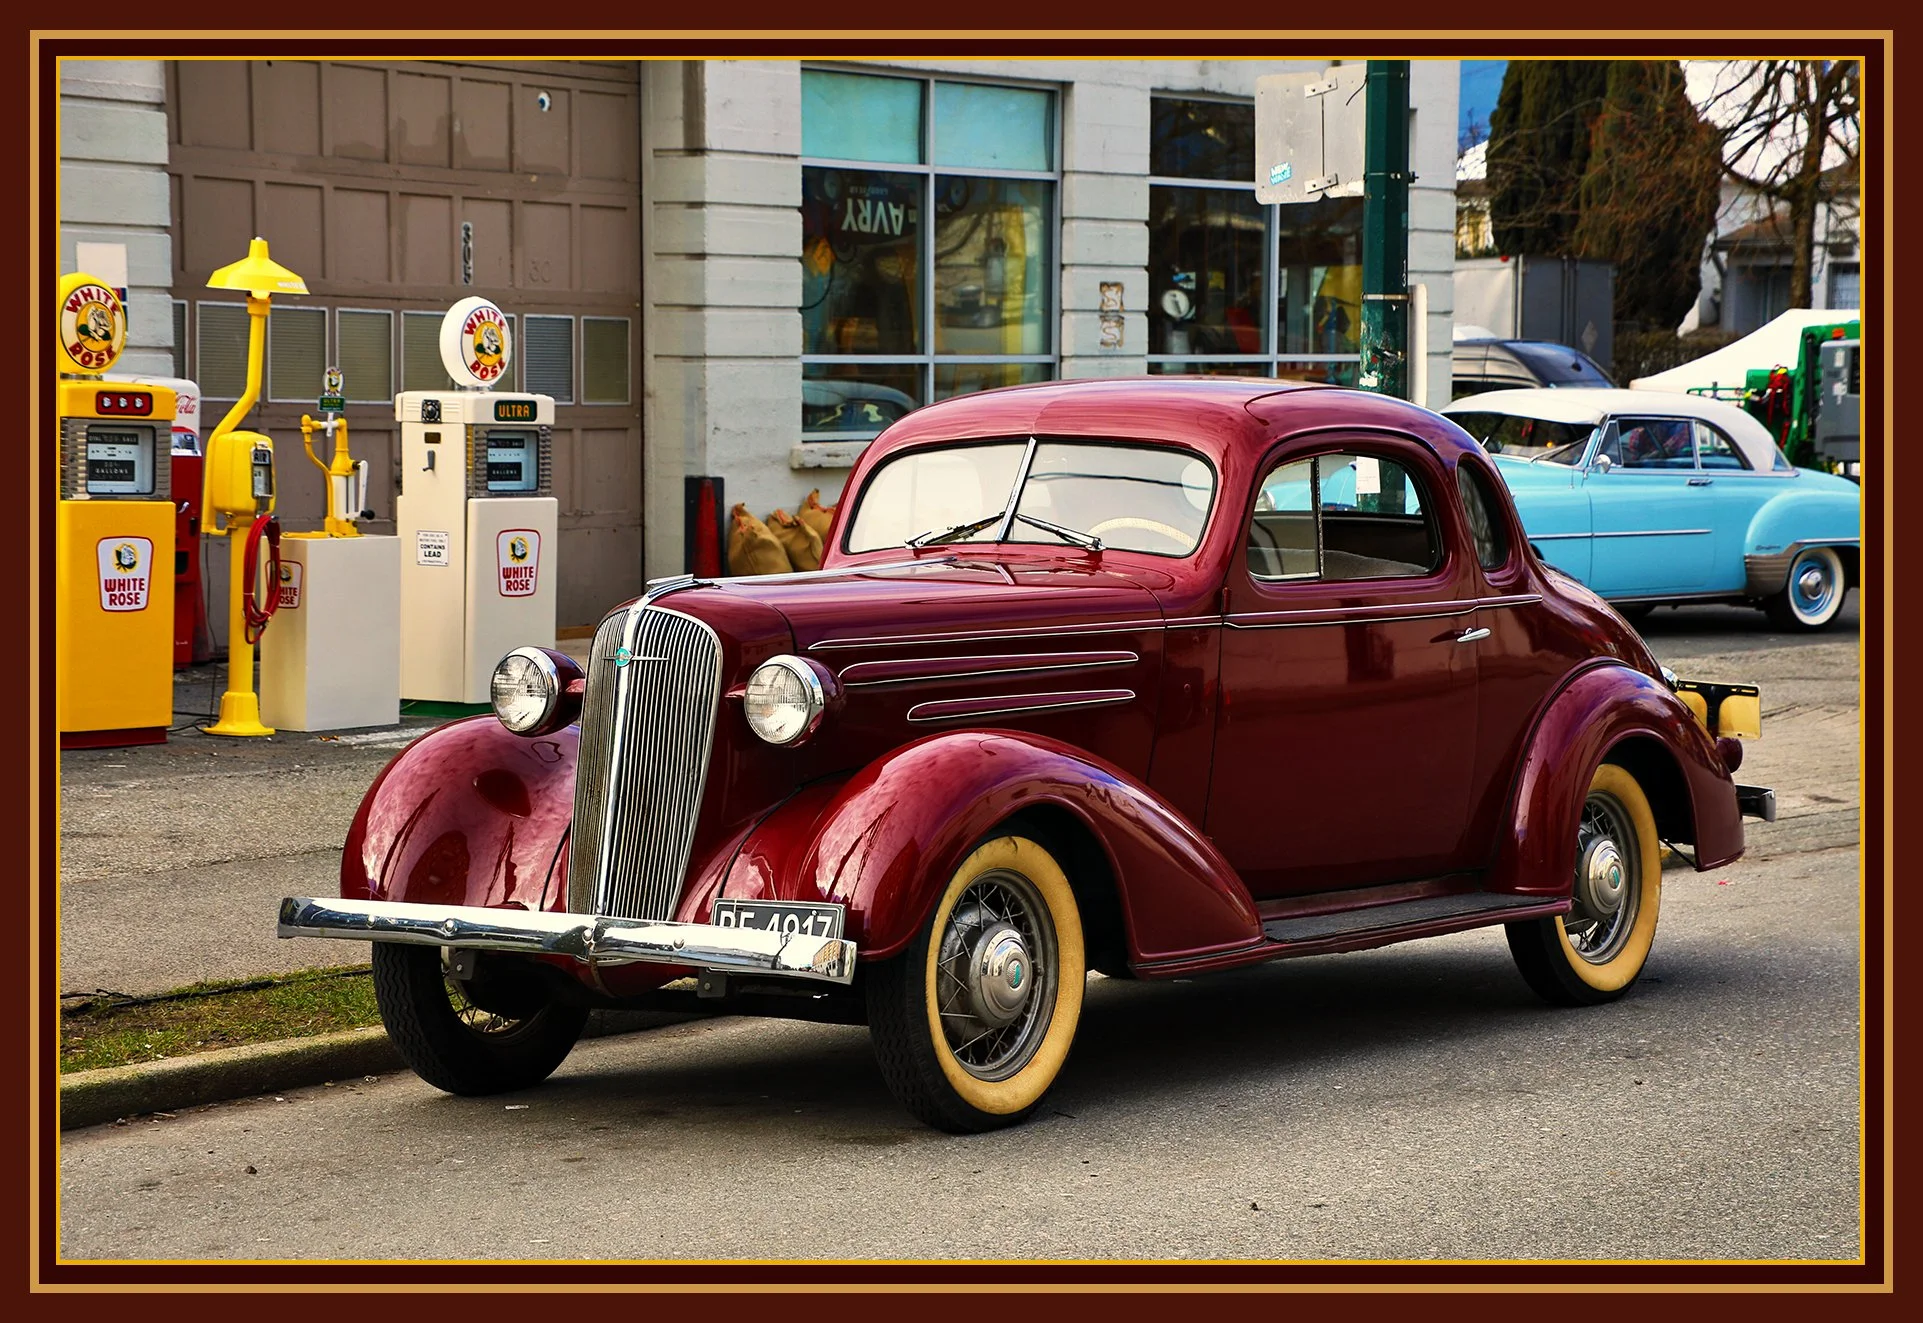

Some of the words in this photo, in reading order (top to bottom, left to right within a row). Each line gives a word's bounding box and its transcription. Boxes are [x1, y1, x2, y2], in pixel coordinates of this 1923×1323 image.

[1270, 162, 1290, 177] NEW
[1270, 168, 1291, 185] WAVE
[66, 287, 121, 316] WHITE
[464, 309, 505, 335] WHITE
[68, 343, 117, 367] ROSE
[470, 357, 505, 380] ROSE
[498, 404, 530, 418] ULTRA
[253, 451, 268, 463] AIR
[420, 543, 446, 551] CONTAINS
[423, 550, 442, 558] LEAD
[503, 566, 534, 580] WHITE
[104, 578, 145, 592] WHITE
[280, 587, 298, 596] HITE
[505, 579, 530, 591] ROSE
[109, 592, 141, 606] ROSE
[280, 596, 294, 605] OSE
